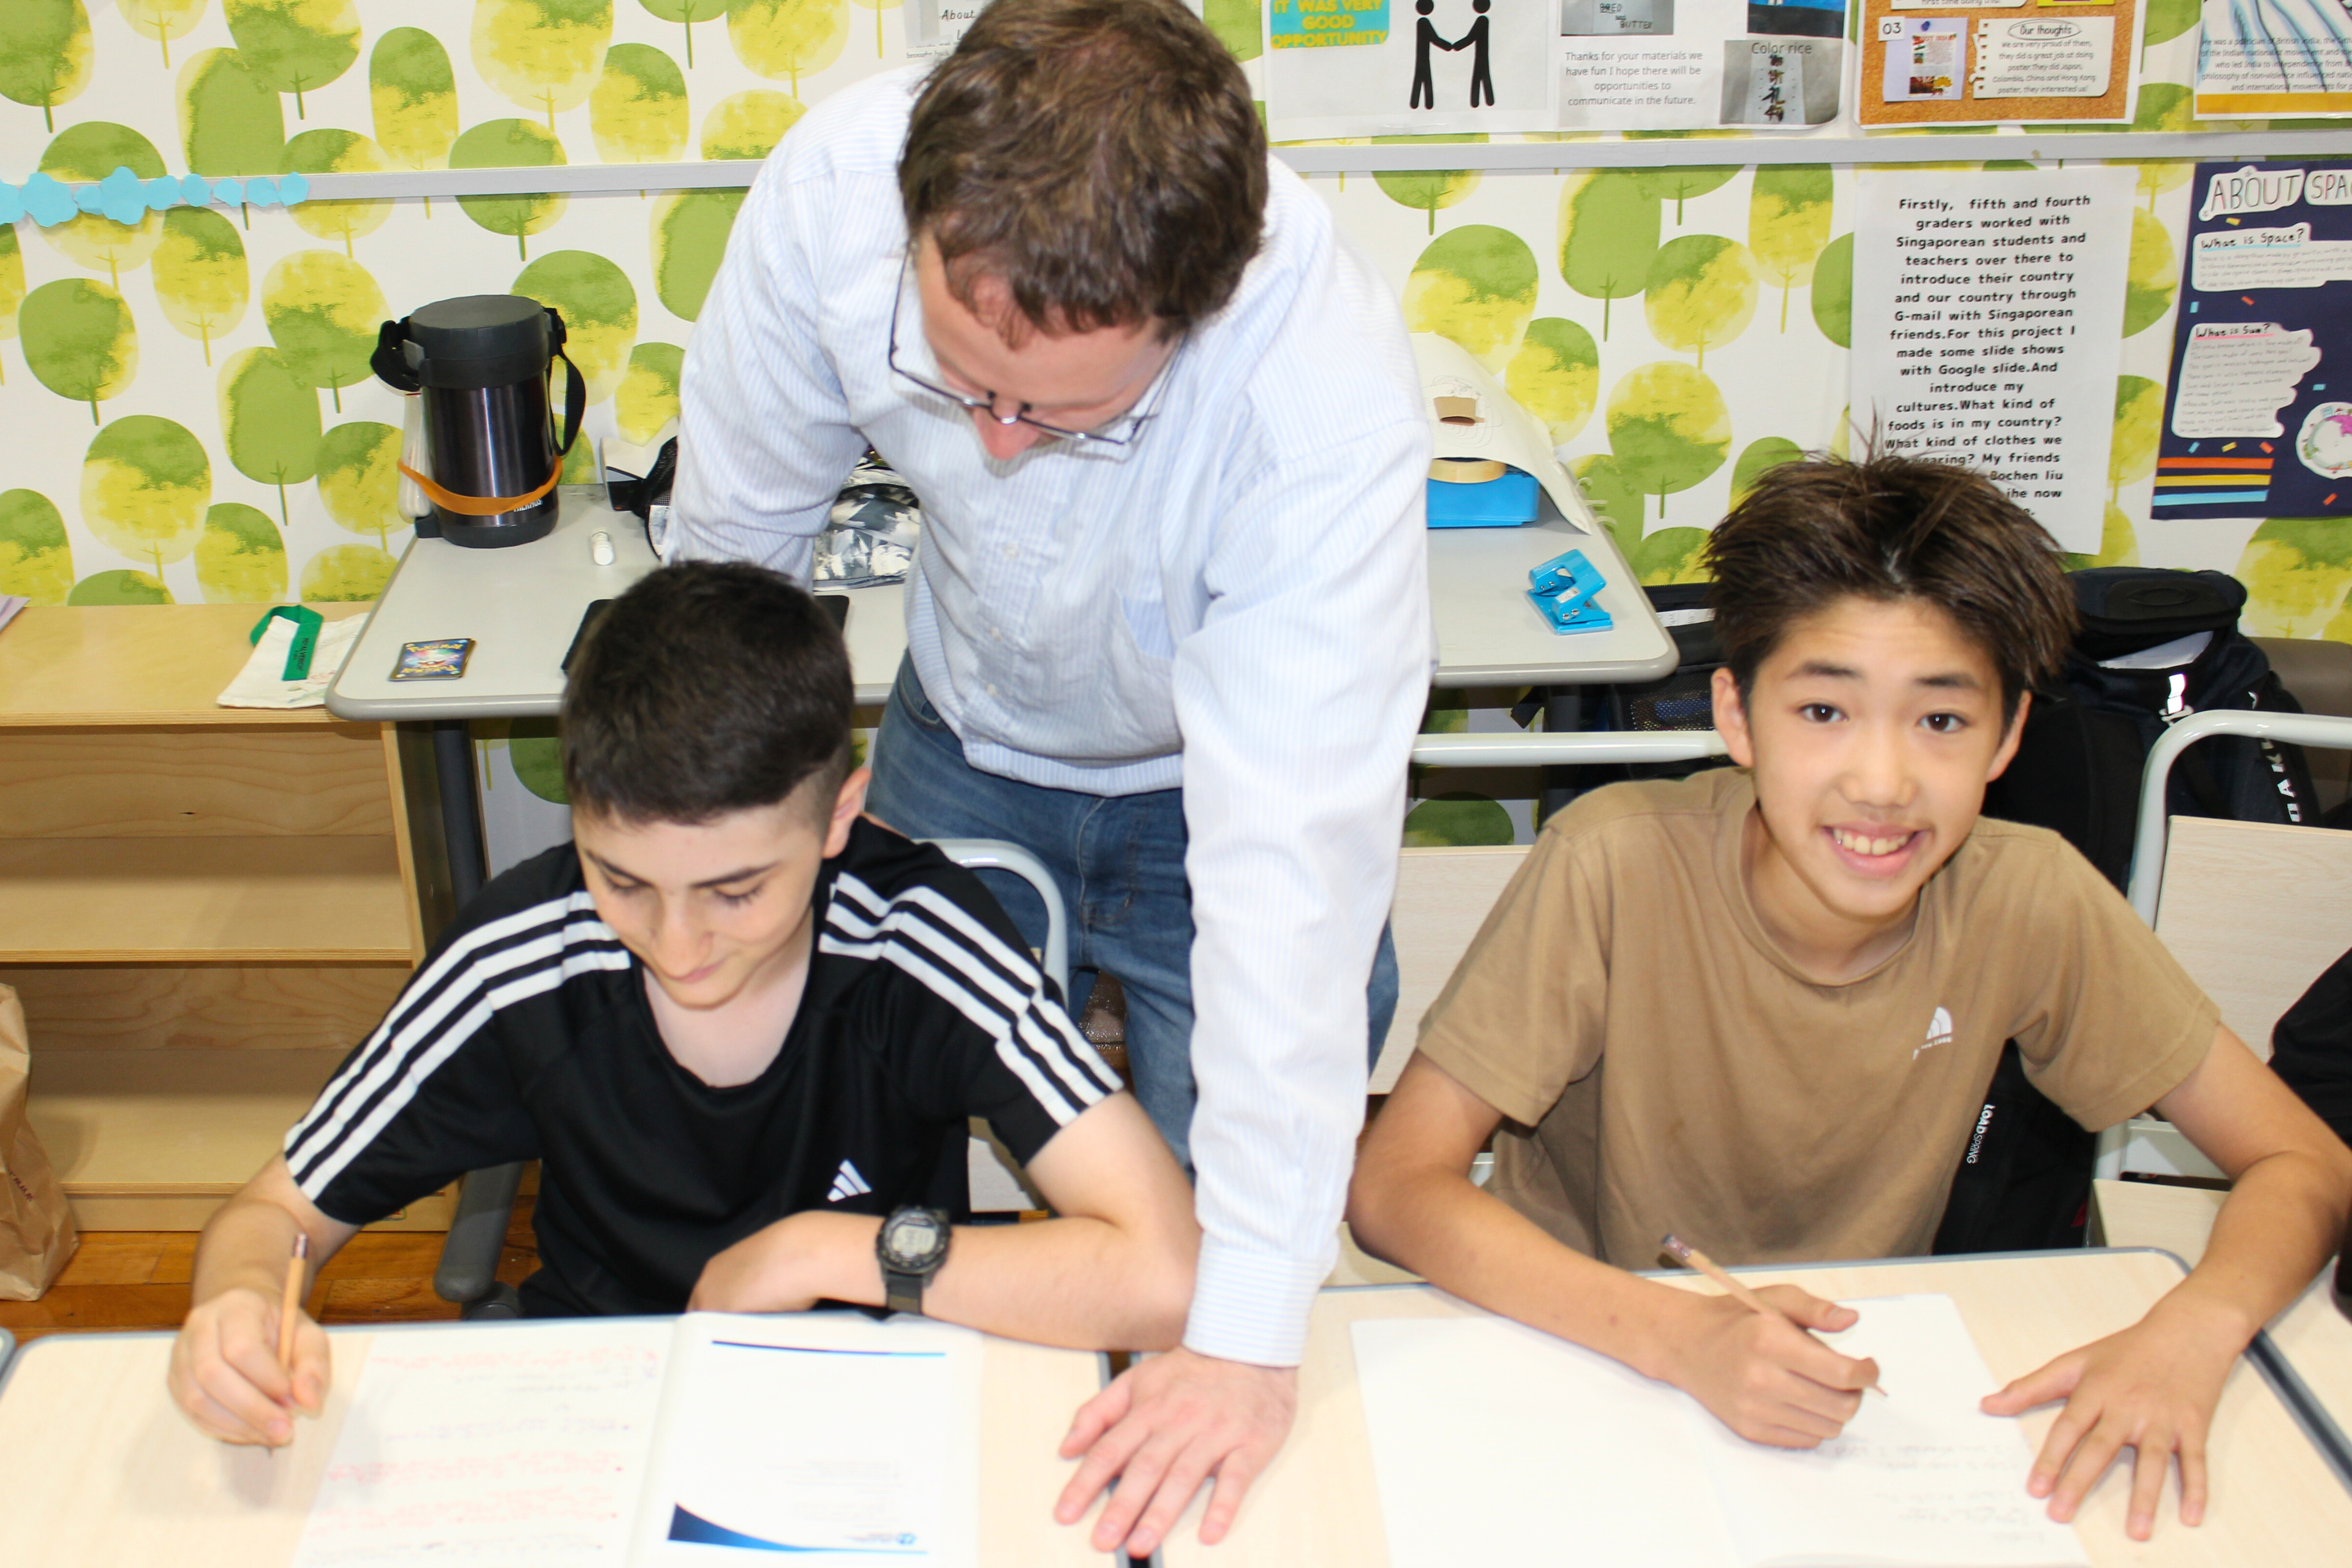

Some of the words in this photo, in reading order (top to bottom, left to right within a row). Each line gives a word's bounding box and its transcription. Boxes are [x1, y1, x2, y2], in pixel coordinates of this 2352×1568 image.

[1273, 0, 1290, 13] IT
[1297, 0, 1338, 13] WAS
[1341, 0, 1382, 11] VERY
[941, 9, 975, 20] About
[1302, 14, 1355, 30] GOOD
[1882, 22, 1902, 34] 03
[1270, 30, 1388, 49] OPPORTUNITY
[1751, 42, 1784, 54] Color
[1788, 42, 1812, 54] rice
[1565, 52, 1599, 61] Thanks
[1602, 51, 1615, 61] for
[1617, 53, 1639, 62] your
[1642, 51, 1686, 60] materials
[1566, 67, 1588, 76] have
[1591, 66, 1606, 75] fun
[1609, 67, 1613, 75] I
[1616, 67, 1640, 77] hope
[1642, 66, 1668, 75] there
[1670, 66, 1686, 75] will
[1689, 66, 1702, 75] be
[1594, 81, 1659, 92] opportunities
[1568, 96, 1633, 106] communicate
[1635, 96, 1643, 105] in
[1646, 96, 1662, 105] the
[1664, 95, 1696, 105] future.
[2210, 174, 2301, 212] ABOUT
[1899, 198, 1953, 213] Firstly,
[1969, 198, 2006, 209] fifth
[2013, 197, 2038, 209] and
[2045, 195, 2090, 208] fourth
[1916, 217, 1973, 232] graders
[1980, 216, 2032, 228] worked
[2039, 214, 2070, 226] with
[1896, 236, 1986, 251] Singaporean
[1992, 235, 2054, 247] students
[2060, 232, 2086, 244] and
[2200, 238, 2236, 249] What
[2244, 235, 2254, 244] is
[2260, 228, 2304, 246] Space?
[1905, 255, 1969, 266] teachers
[1975, 257, 2007, 266] over
[2014, 253, 2052, 265] there
[2058, 252, 2074, 262] to
[1901, 274, 1971, 285] introduce
[1978, 273, 2014, 284] their
[2019, 271, 2075, 284] country
[1894, 292, 1920, 303] and
[1958, 292, 2014, 304] country
[2020, 288, 2076, 302] through
[1894, 310, 1941, 322] G-mail
[1948, 310, 1981, 321] with
[1988, 309, 2073, 322] Singaporean
[1977, 327, 2005, 339] this
[2011, 325, 2063, 340] project
[2070, 325, 2075, 336] I
[1896, 347, 1933, 358] made
[1940, 349, 1975, 357] some
[1981, 345, 2015, 356] slide
[2021, 344, 2064, 355] shows
[1900, 365, 1932, 376] with
[1938, 364, 1986, 377] Google
[1929, 382, 1997, 393] introduce
[2003, 383, 2024, 394] my
[2002, 398, 2034, 409] kind
[2039, 398, 2056, 409] of
[1887, 420, 1926, 431] foods
[1932, 418, 1944, 429] is
[1951, 418, 1964, 428] in
[1971, 420, 1991, 431] my
[1997, 416, 2062, 429] country?
[1885, 438, 1919, 449] What
[1926, 436, 1956, 447] kind
[1962, 435, 1978, 447] of
[1985, 434, 2036, 446] clothes
[1981, 453, 2001, 466] My
[2008, 452, 2060, 463] friends
[1990, 471, 2038, 481] Bochen
[2045, 470, 2064, 480] liu
